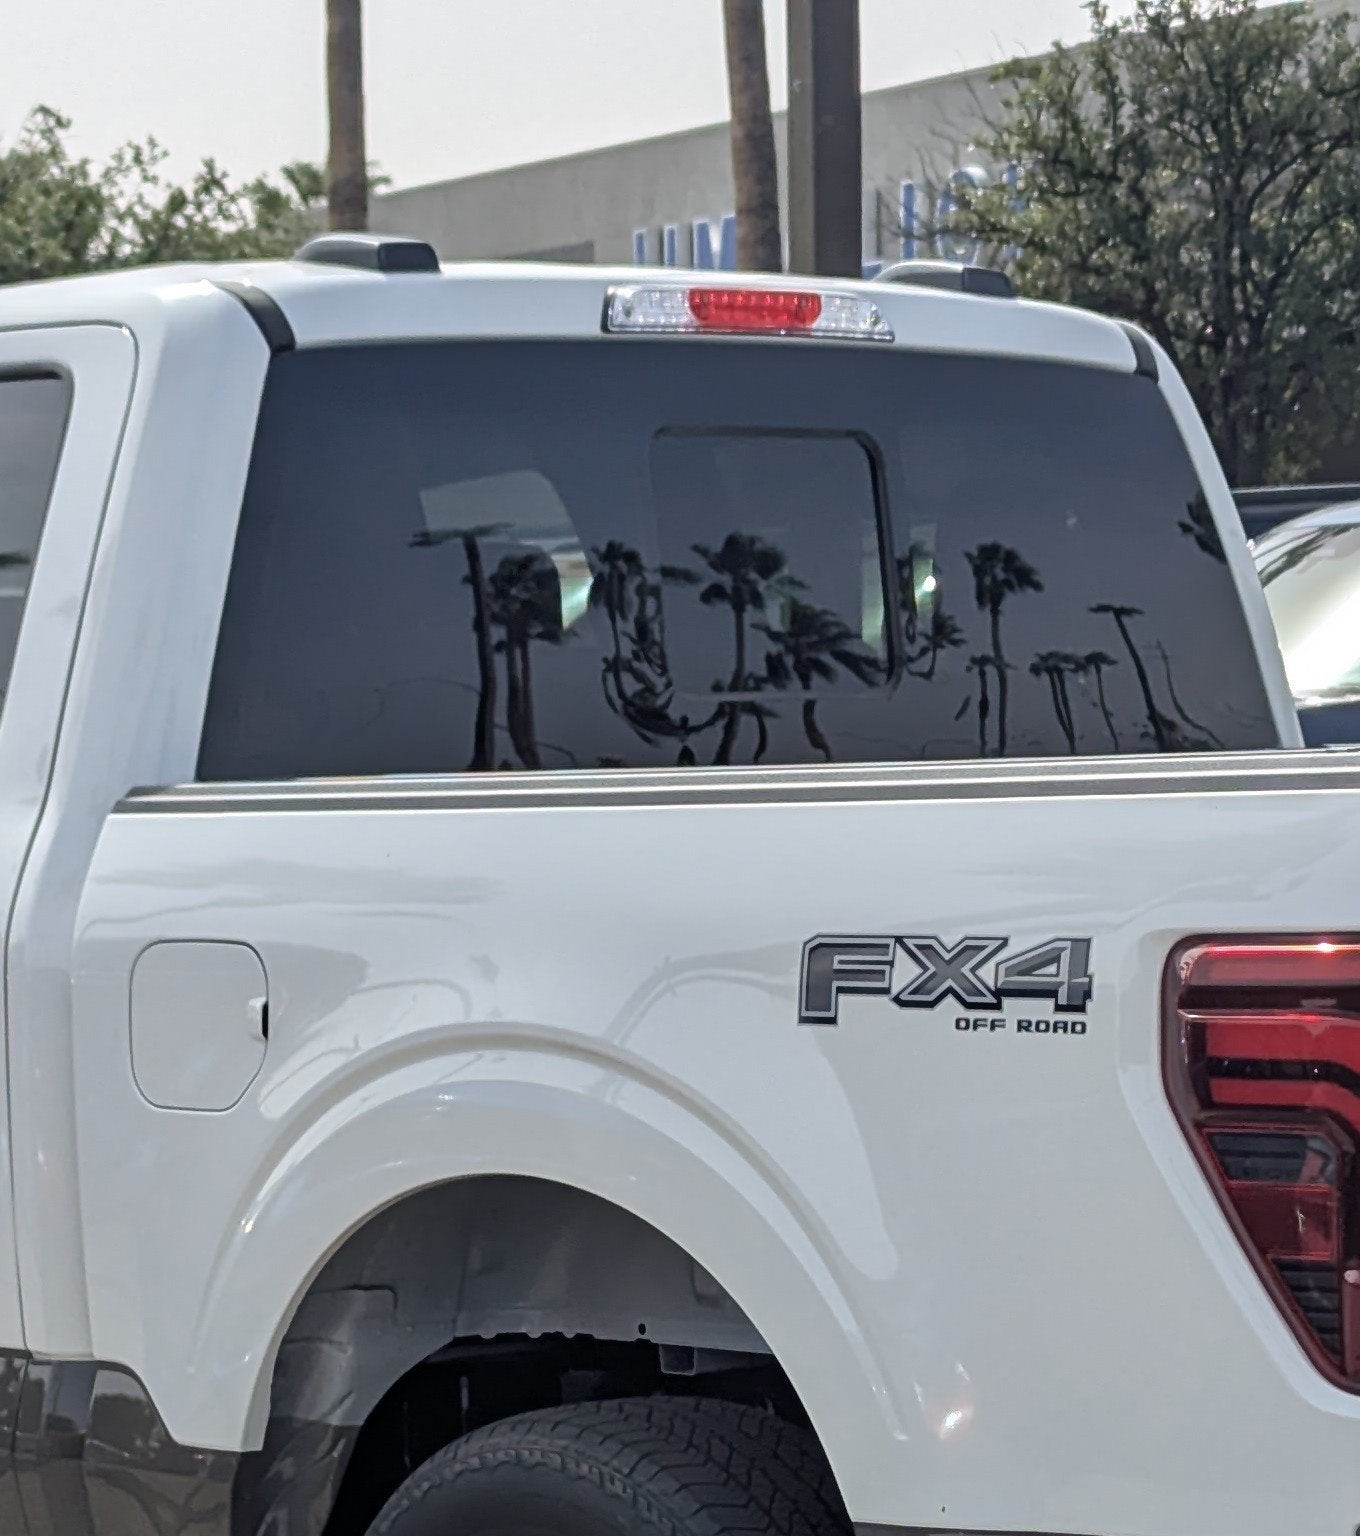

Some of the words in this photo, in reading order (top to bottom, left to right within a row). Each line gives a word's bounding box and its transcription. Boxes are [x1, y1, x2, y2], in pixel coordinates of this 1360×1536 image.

[797, 933, 1094, 1026] FX4
[954, 1017, 1007, 1033] OFF
[1016, 1018, 1088, 1035] ROAD
